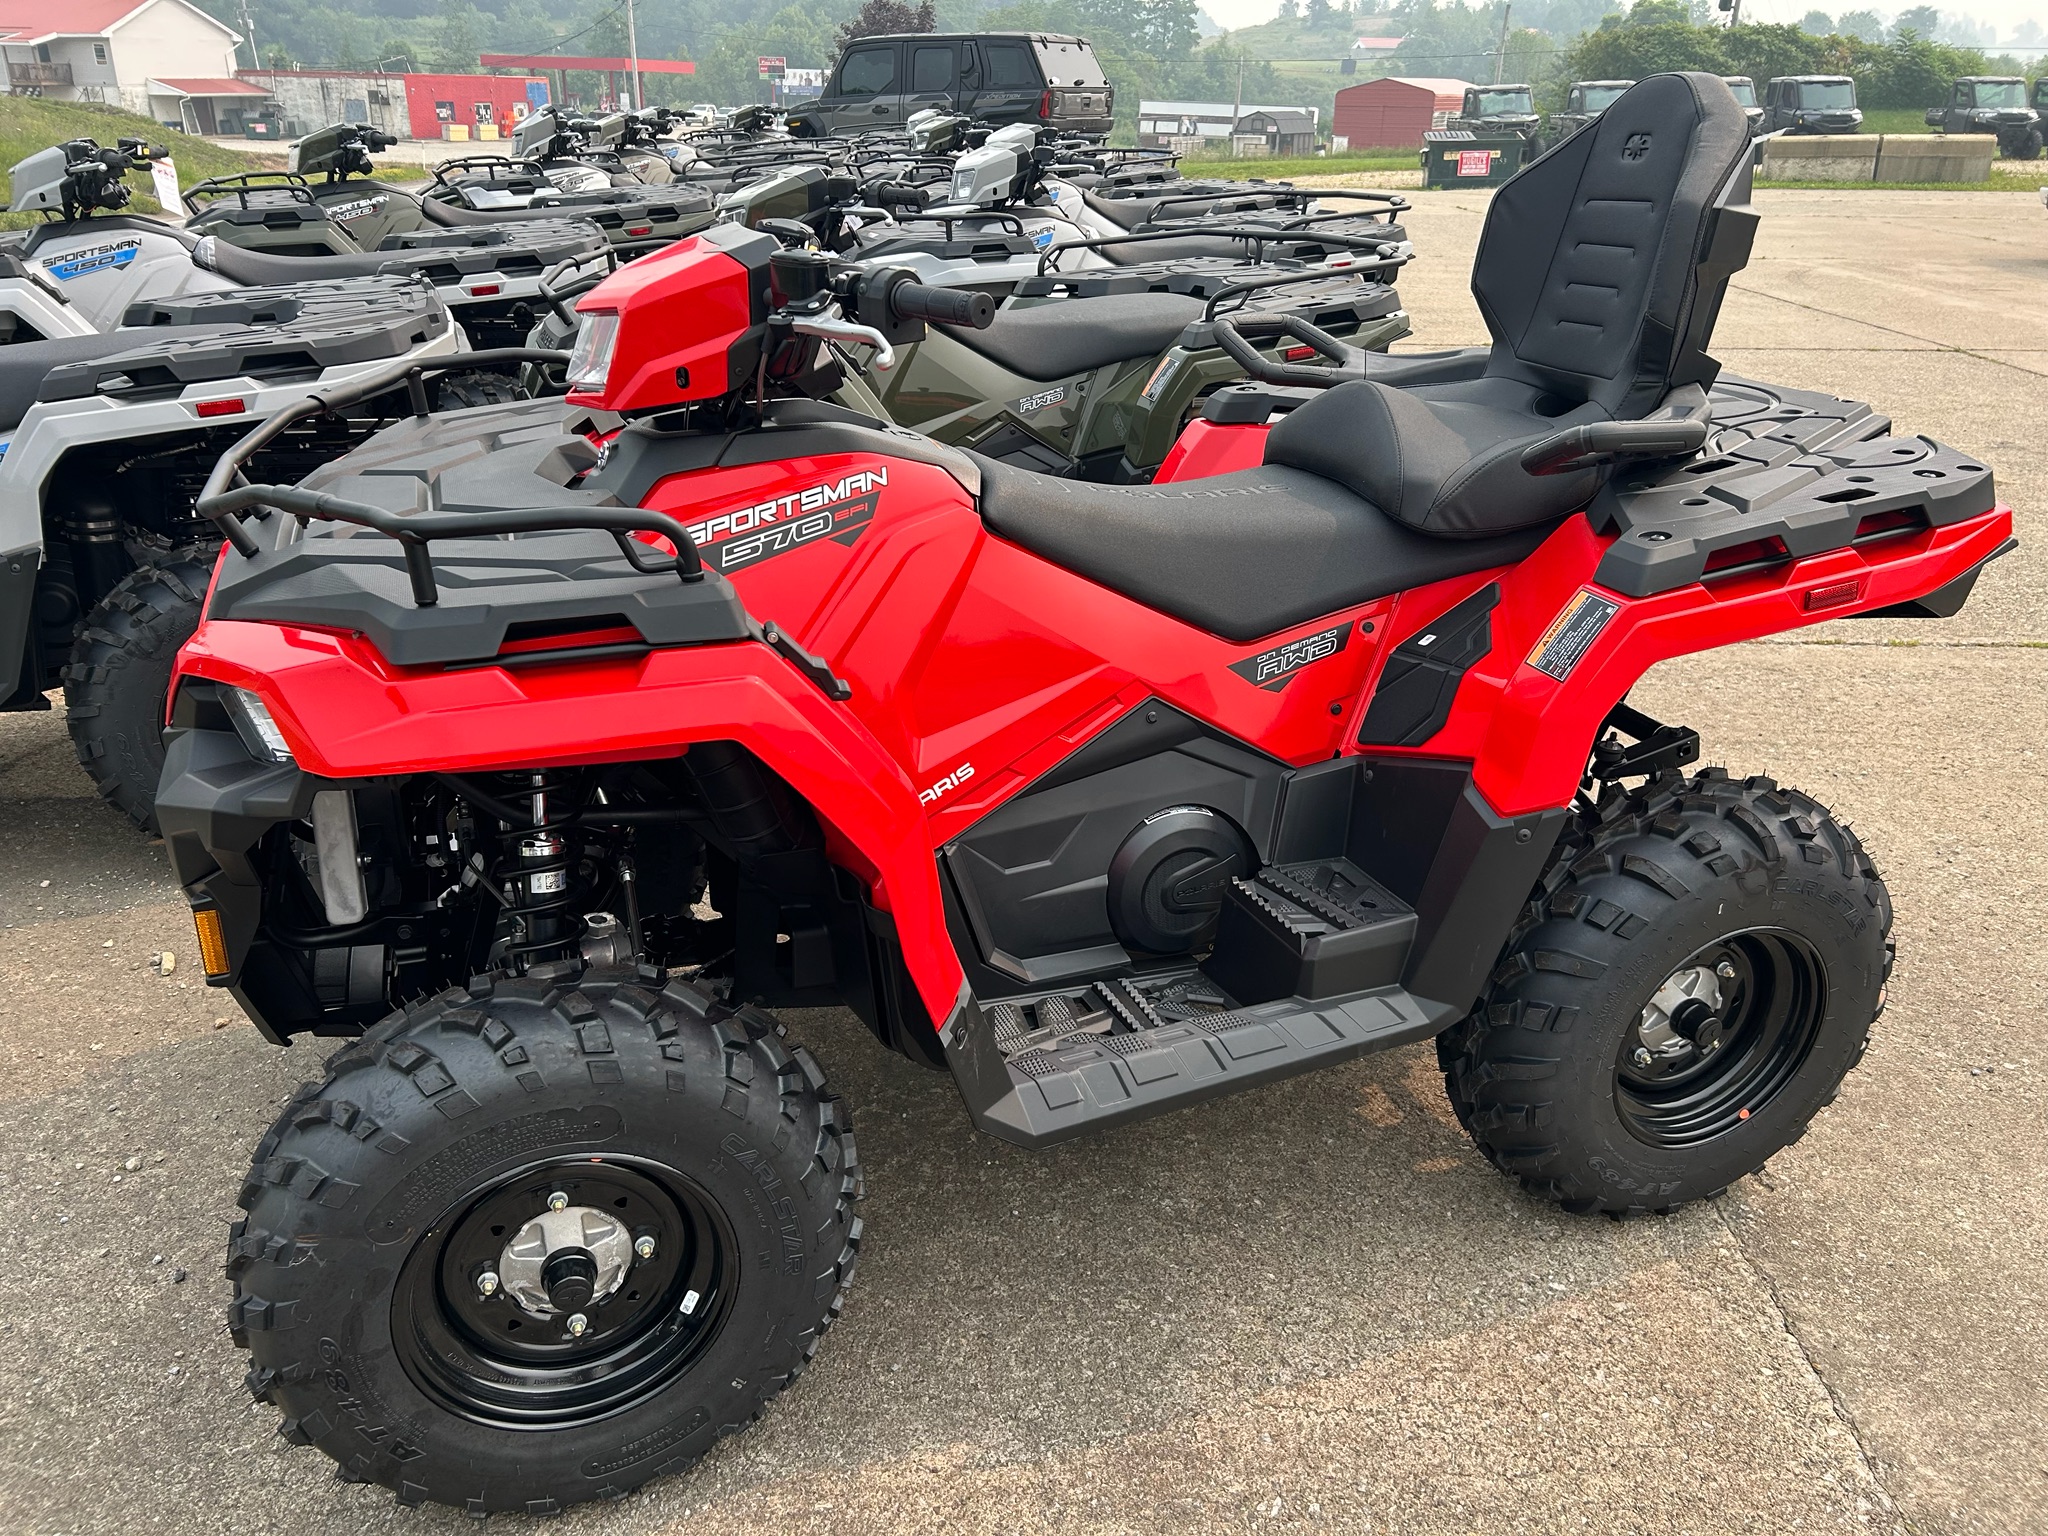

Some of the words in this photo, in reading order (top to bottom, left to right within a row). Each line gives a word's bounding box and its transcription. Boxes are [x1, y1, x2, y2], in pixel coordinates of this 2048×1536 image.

[42, 238, 142, 268] SPORTSMAN
[62, 255, 116, 274] 450
[1019, 396, 1031, 404] ON
[1019, 391, 1064, 413] AWD
[686, 466, 889, 546] SPORTSMAN
[834, 502, 868, 522] EFI
[721, 511, 833, 570] 570
[1547, 608, 1574, 641] WARNING
[1256, 651, 1276, 663] ON
[1281, 629, 1338, 654] DEMAND
[1256, 637, 1338, 681] AWD
[719, 1132, 804, 1277] CARLSTAR
